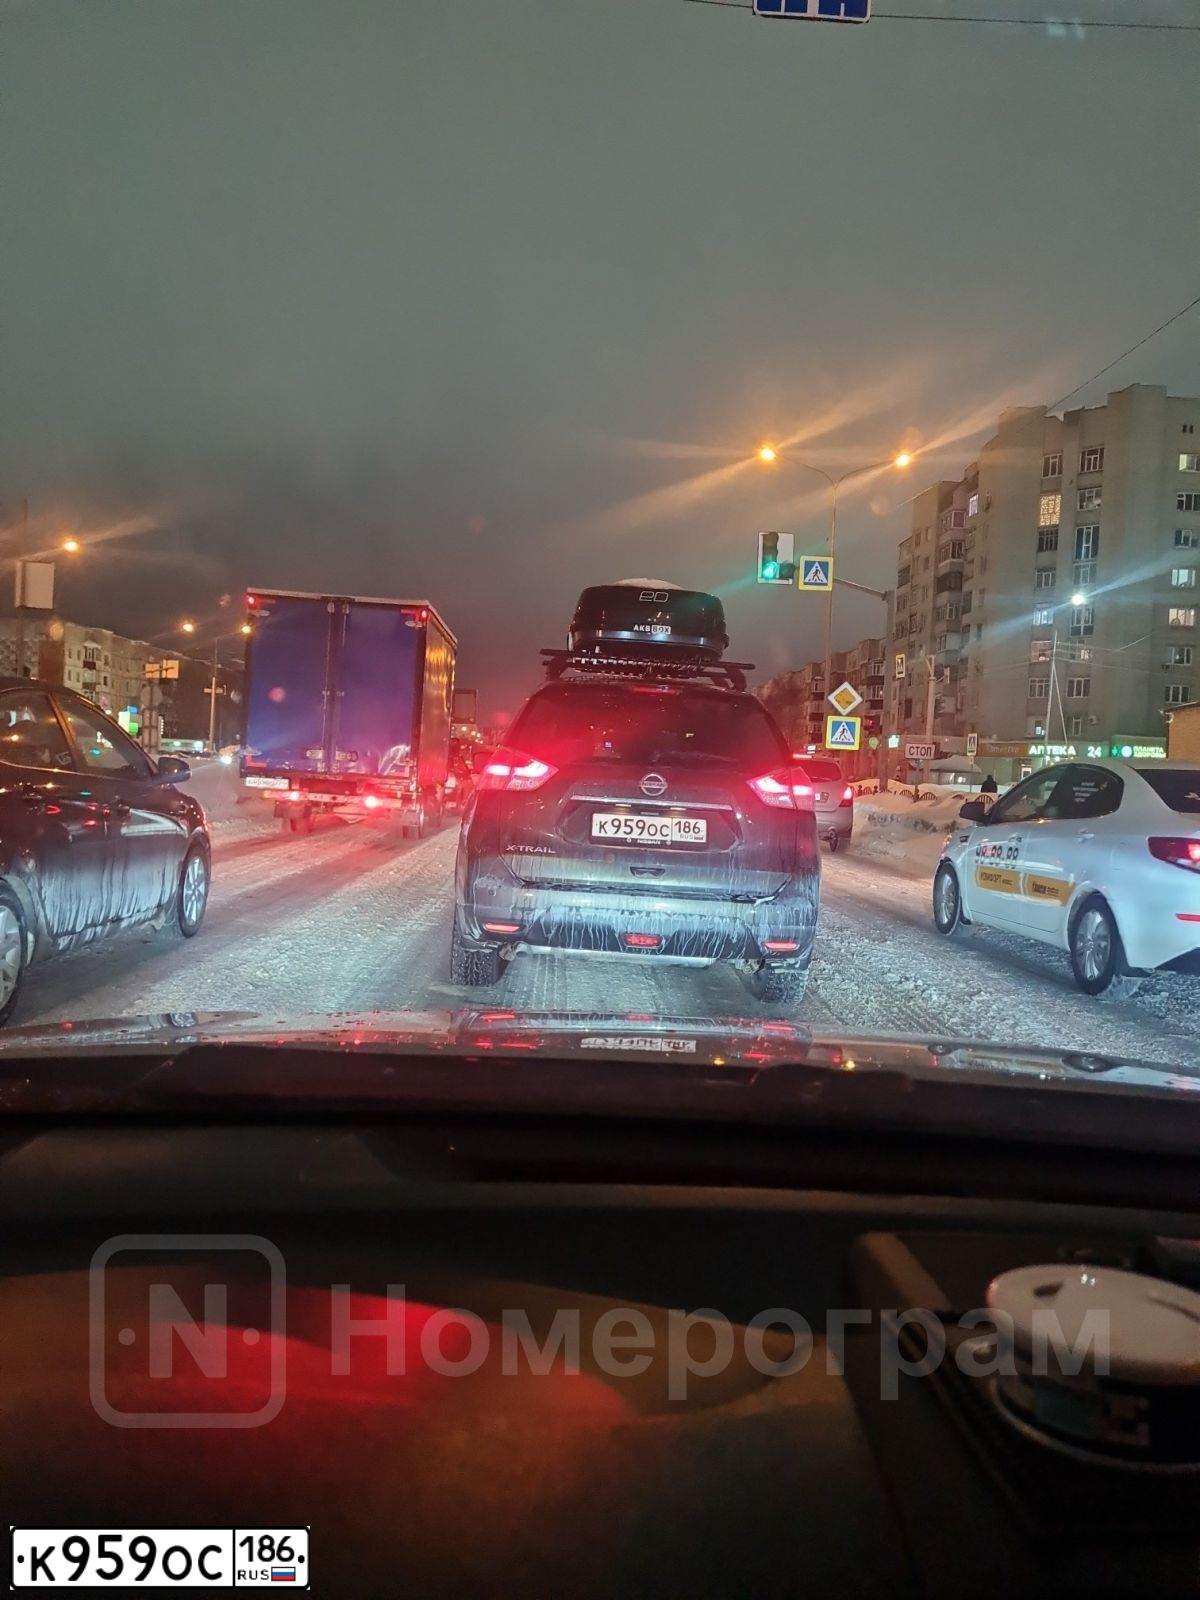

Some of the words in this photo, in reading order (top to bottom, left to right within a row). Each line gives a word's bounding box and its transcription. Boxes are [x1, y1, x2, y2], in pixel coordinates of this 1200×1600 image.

[908, 746, 932, 757] СТОП
[1029, 745, 1076, 755] АПТЕКА
[1087, 746, 1102, 758] 24
[674, 820, 701, 834] 186
[505, 844, 556, 854] X-TRAIL
